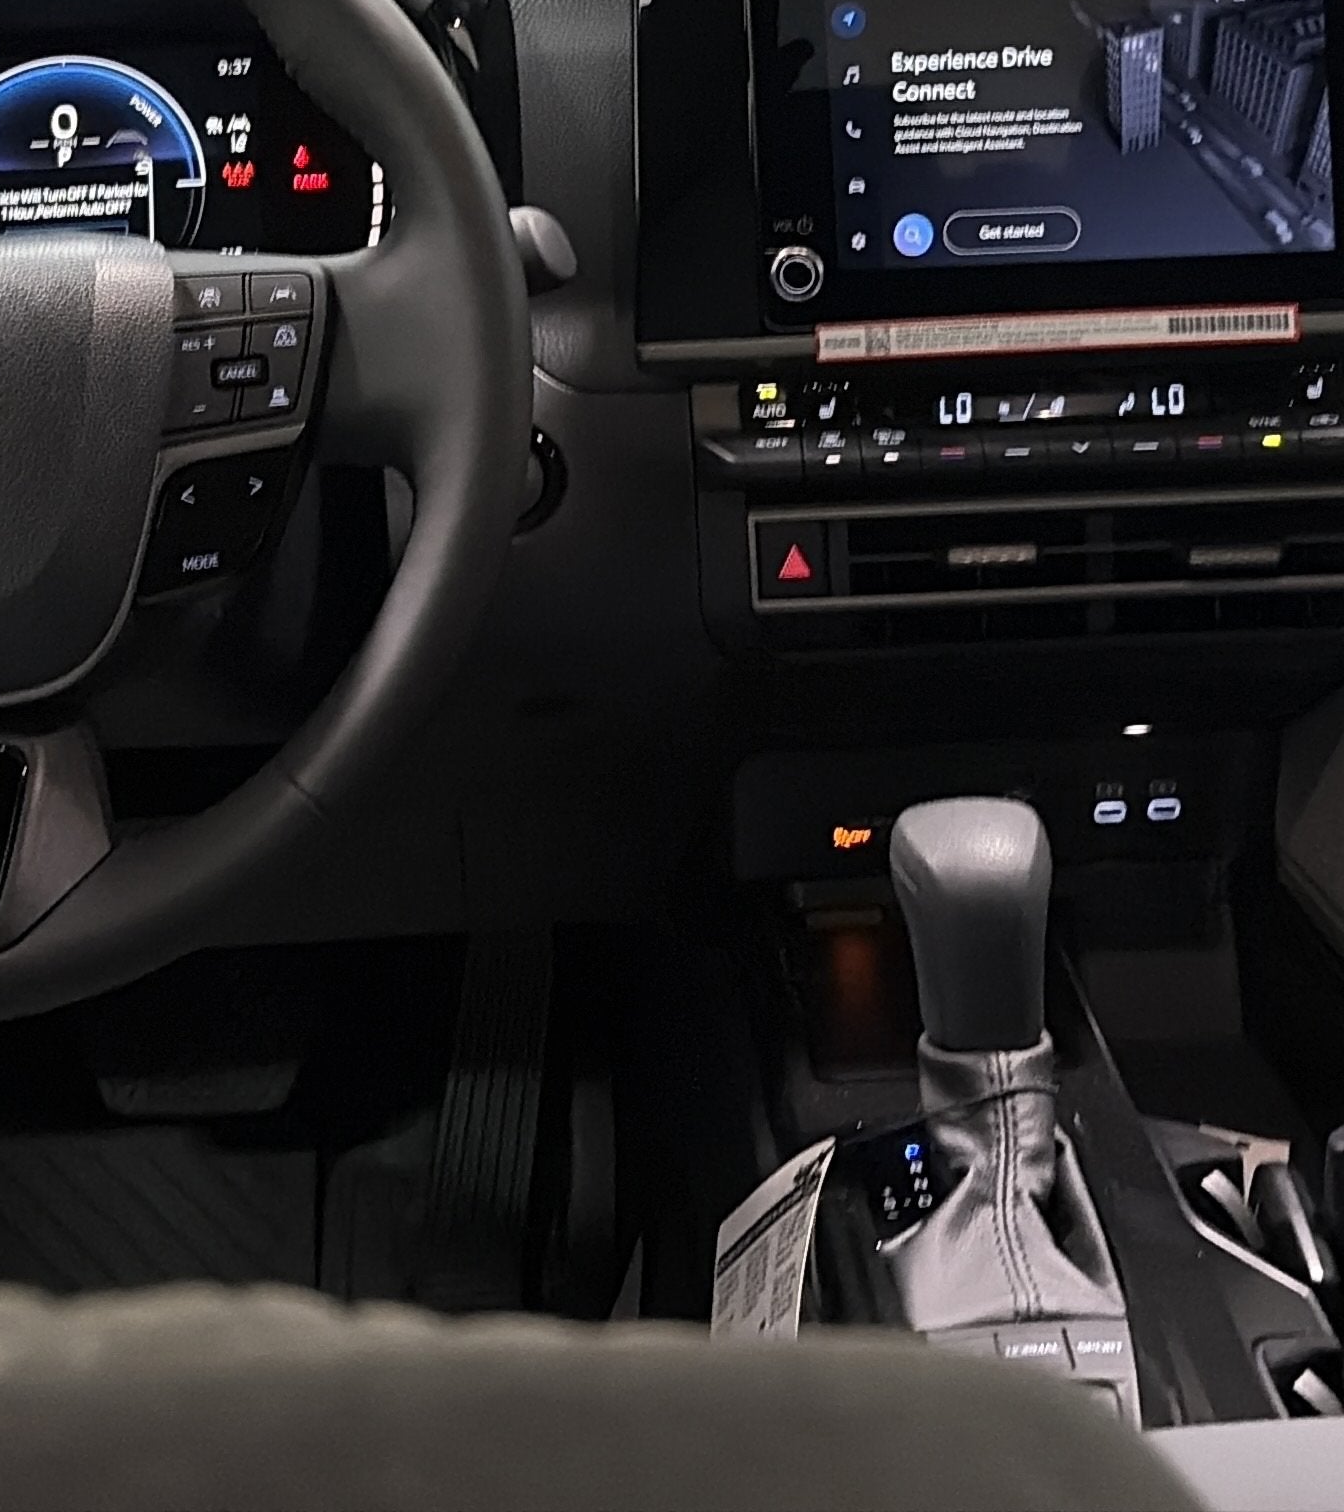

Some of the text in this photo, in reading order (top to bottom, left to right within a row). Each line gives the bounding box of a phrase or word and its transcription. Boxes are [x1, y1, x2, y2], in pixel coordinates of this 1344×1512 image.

[217, 57, 252, 76] 9:37
[891, 45, 1053, 76] Experience Drive
[892, 79, 976, 102] Connect
[1016, 107, 1033, 122] and
[921, 140, 939, 154] and
[979, 221, 1045, 240] Get started
[939, 392, 973, 425] LO
[1151, 383, 1185, 416] LO
